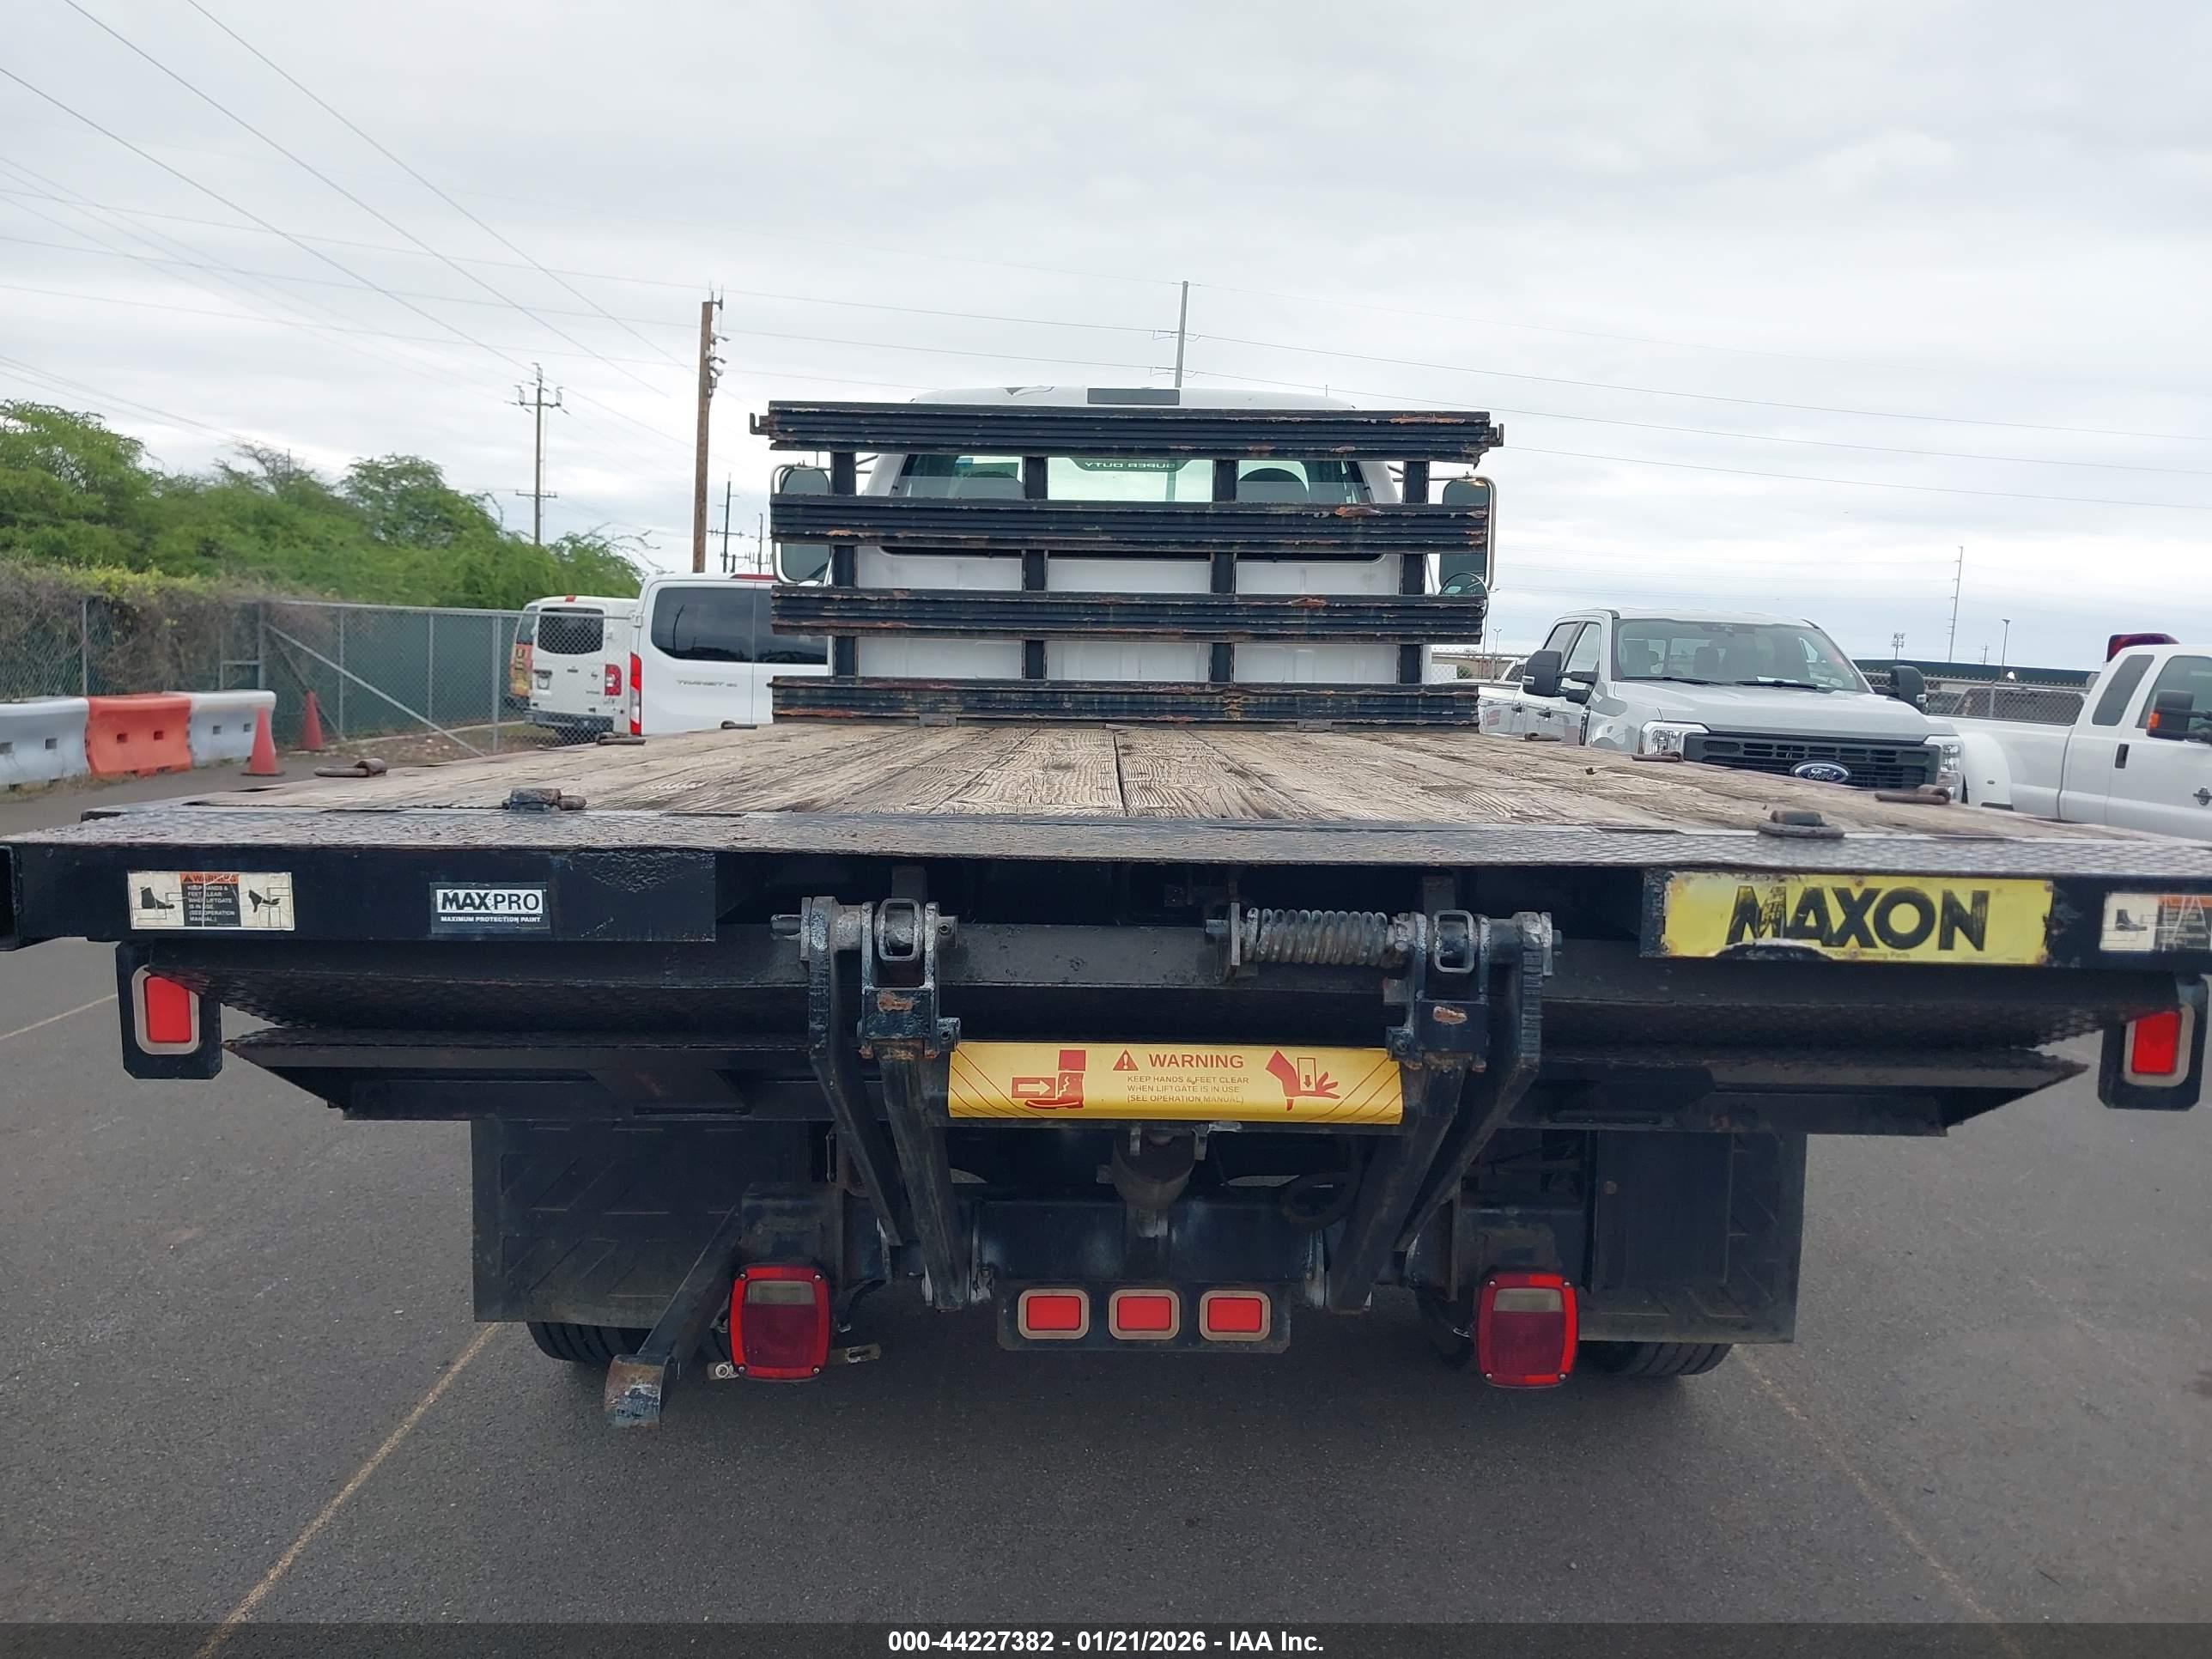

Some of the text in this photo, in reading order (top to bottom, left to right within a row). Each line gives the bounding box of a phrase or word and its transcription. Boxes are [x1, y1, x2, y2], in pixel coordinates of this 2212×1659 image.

[1808, 767, 1837, 781] Ford
[1725, 884, 1990, 951] MAXON
[1149, 1054, 1244, 1069] WARNING
[1156, 1085, 1198, 1093] LIFTGATE
[1150, 1095, 1201, 1103] OPERATION
